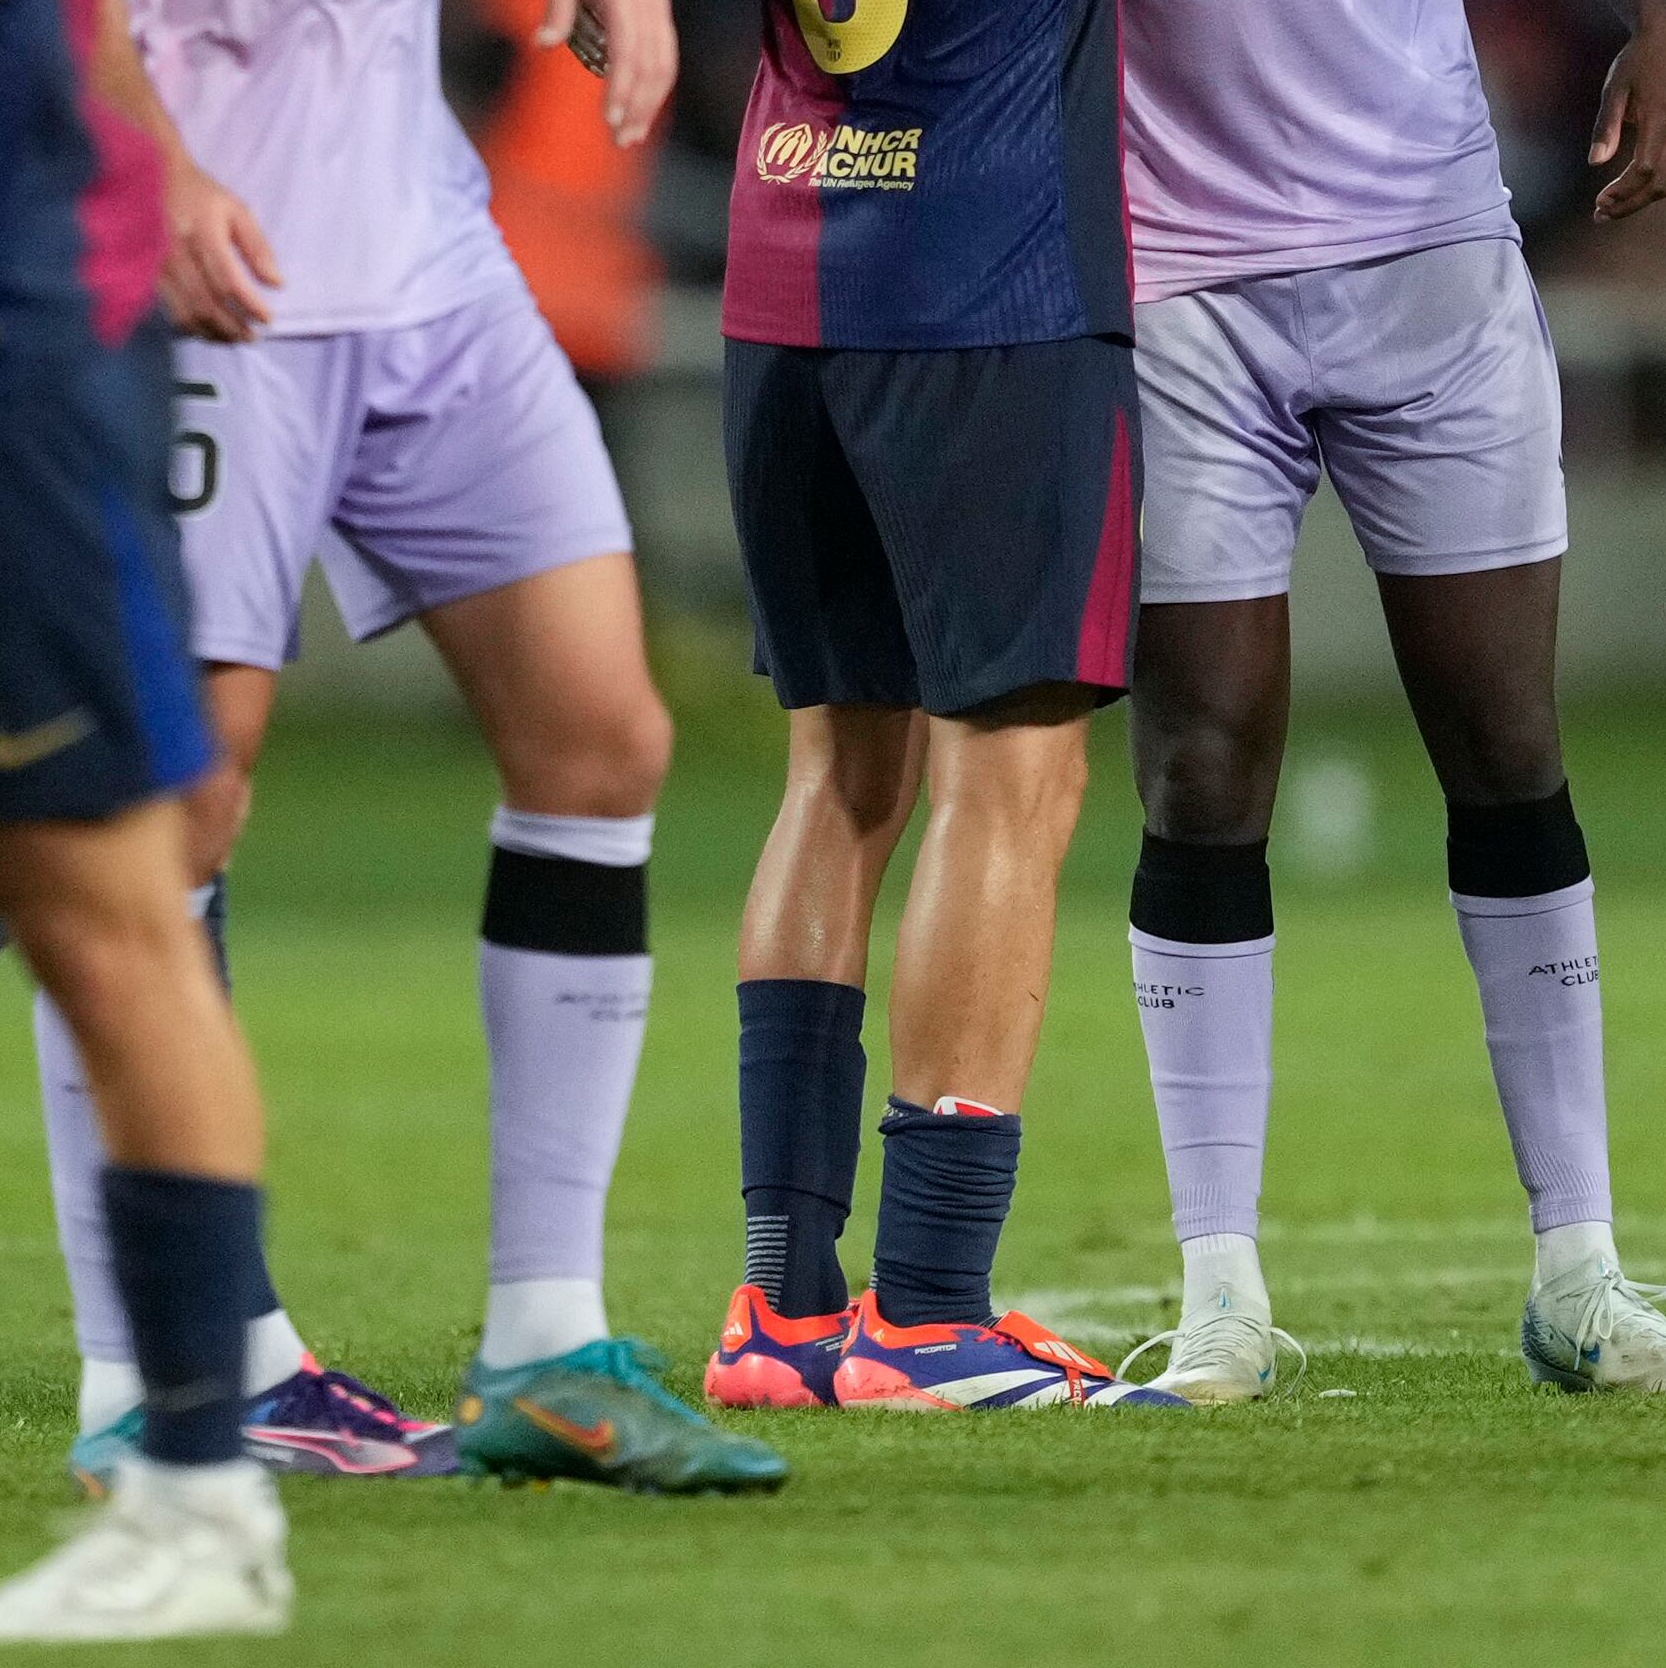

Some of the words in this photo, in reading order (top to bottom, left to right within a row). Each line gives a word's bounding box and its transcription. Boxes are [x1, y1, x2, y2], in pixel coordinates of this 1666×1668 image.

[827, 125, 923, 154] UNHCR
[811, 151, 918, 178] ACNUR
[822, 177, 837, 188] UN
[837, 179, 874, 190] Refugee
[876, 179, 915, 191] Agency
[1137, 996, 1175, 1009] CLUB
